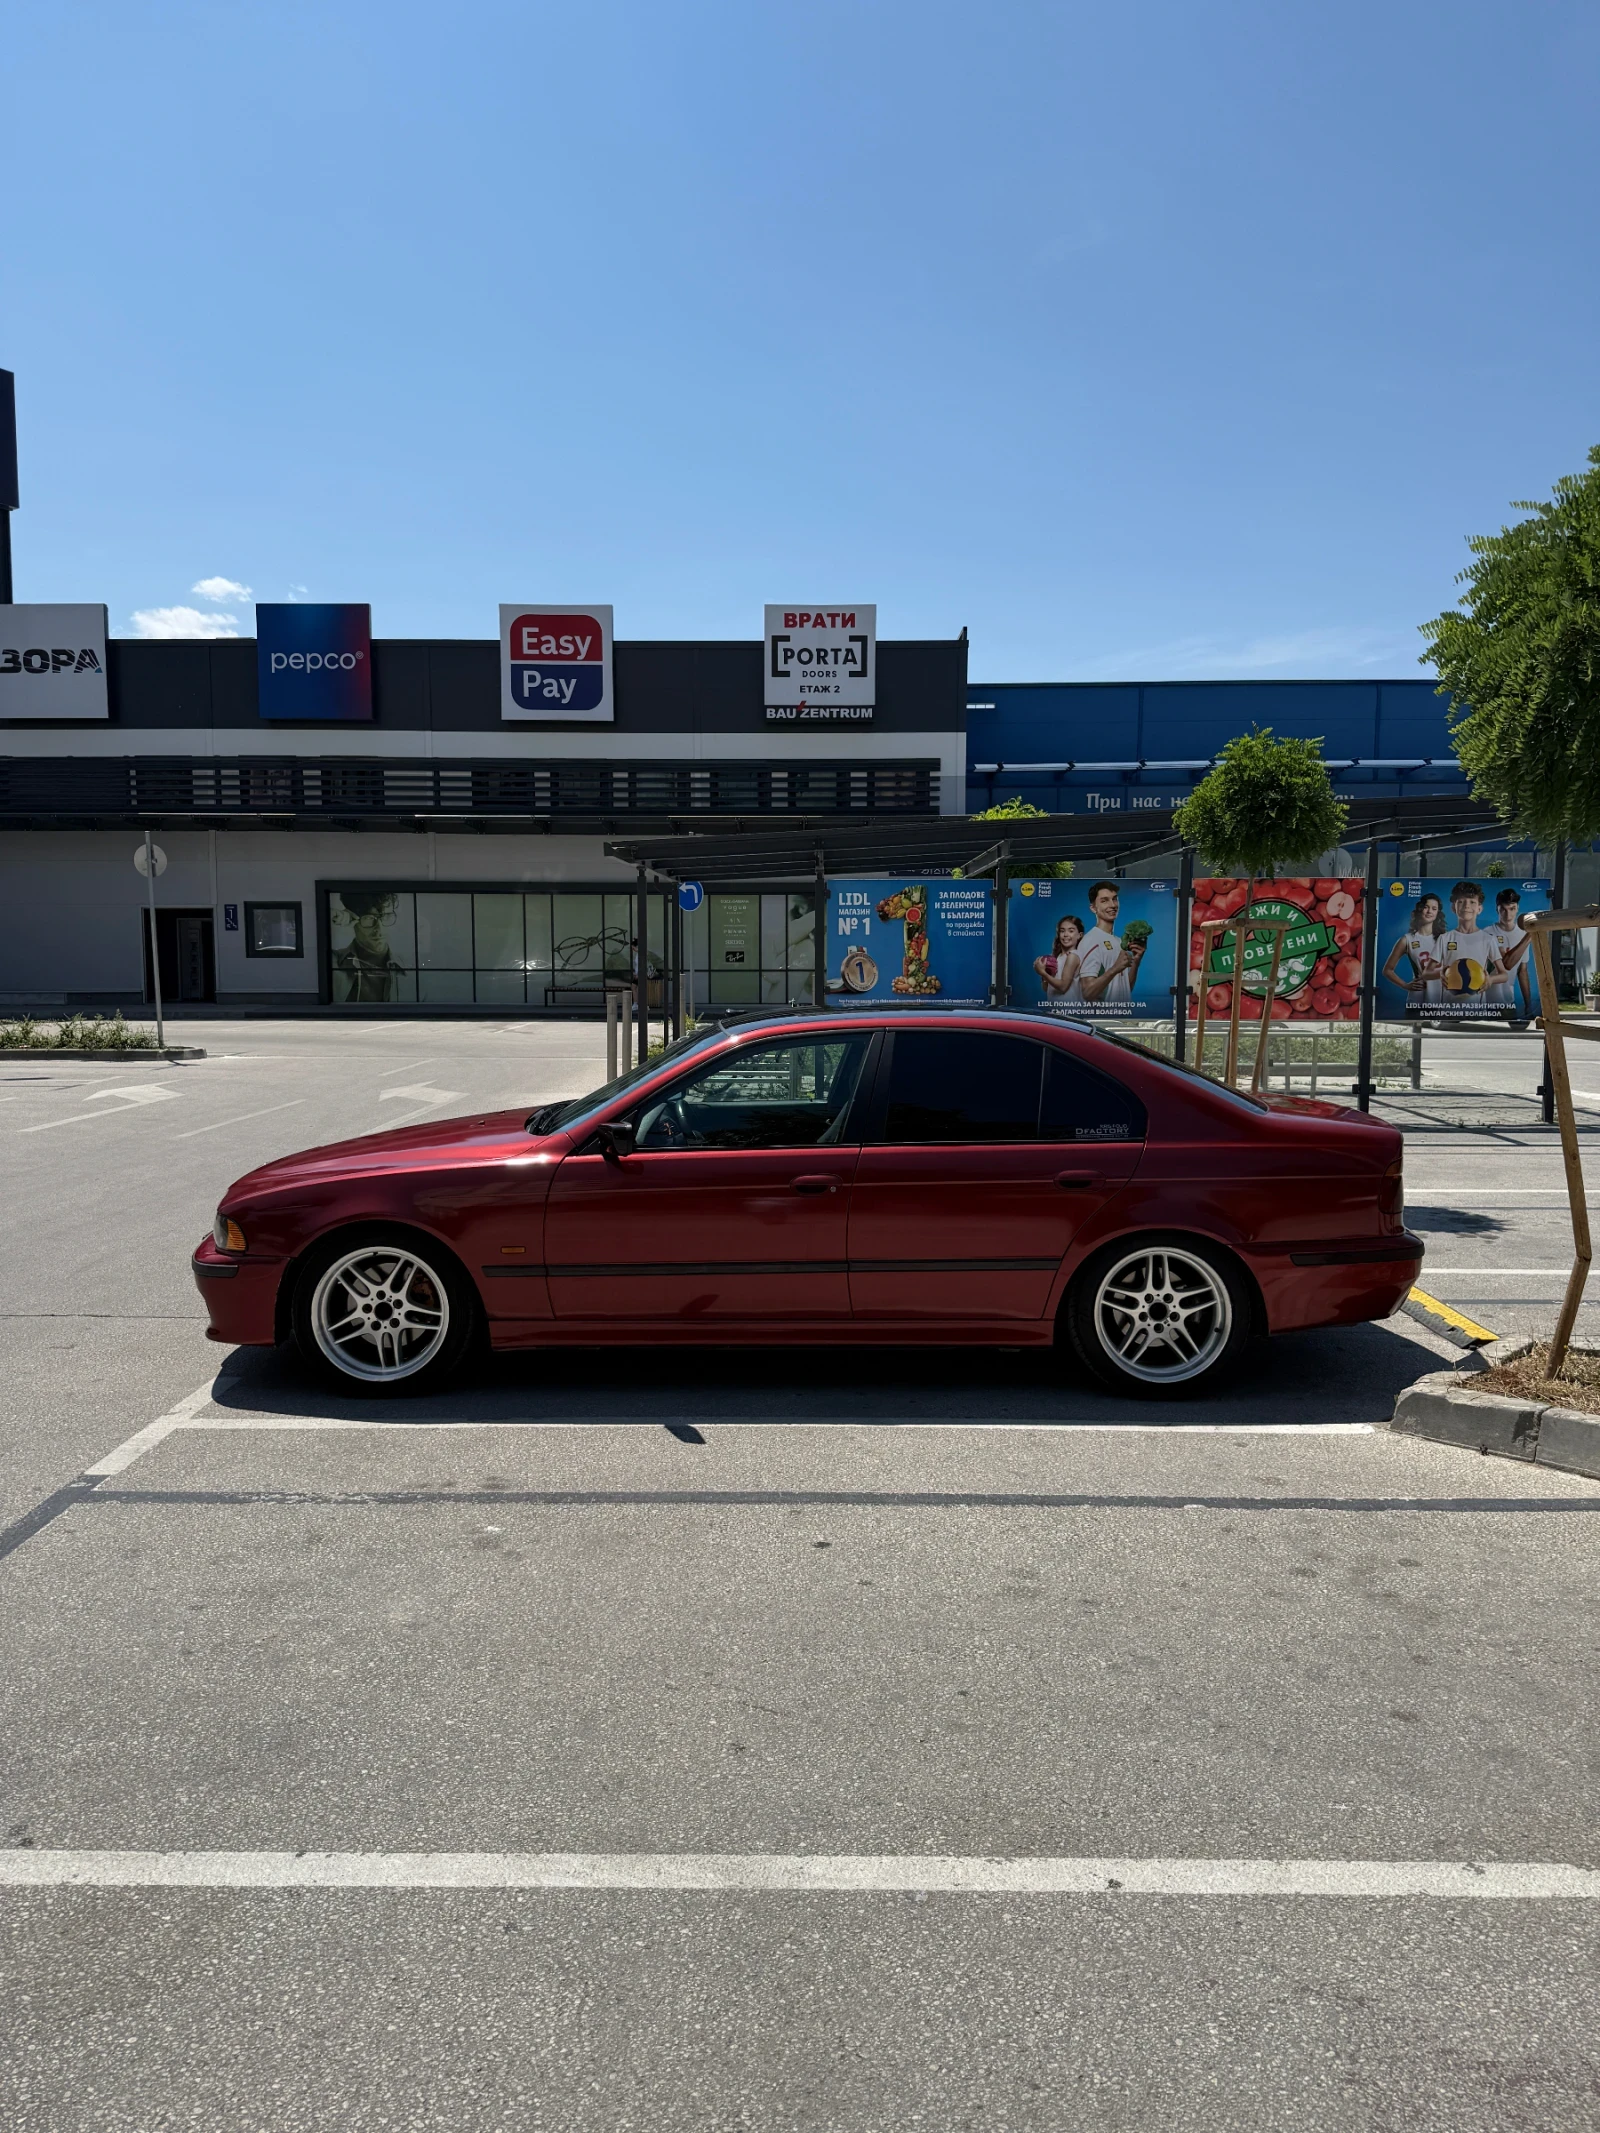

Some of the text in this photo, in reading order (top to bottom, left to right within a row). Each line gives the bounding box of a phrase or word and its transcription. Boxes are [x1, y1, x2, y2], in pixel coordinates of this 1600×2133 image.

[784, 612, 856, 628] ВРАТИ
[522, 627, 592, 660] Easy
[0, 648, 103, 674] ЗОРА
[782, 647, 858, 665] PORTA
[802, 670, 837, 678] DOORS
[523, 670, 577, 704] Pay
[800, 685, 840, 693] ЕТАЖ 2
[1086, 793, 1121, 813] При
[1132, 797, 1161, 808] нас
[838, 892, 871, 906] LIDL
[939, 891, 985, 900] ЗА ПЛОДОВЕ
[838, 908, 871, 916] МАГАЗИН
[934, 901, 985, 910] И ЗЕЛЕНЧУЦИ
[947, 911, 985, 919] БЪЛГАРИЯ
[1287, 910, 1298, 921] И
[862, 917, 871, 936] 1
[1221, 932, 1318, 966] ПОВЕЕНИ
[855, 961, 866, 984] 1
